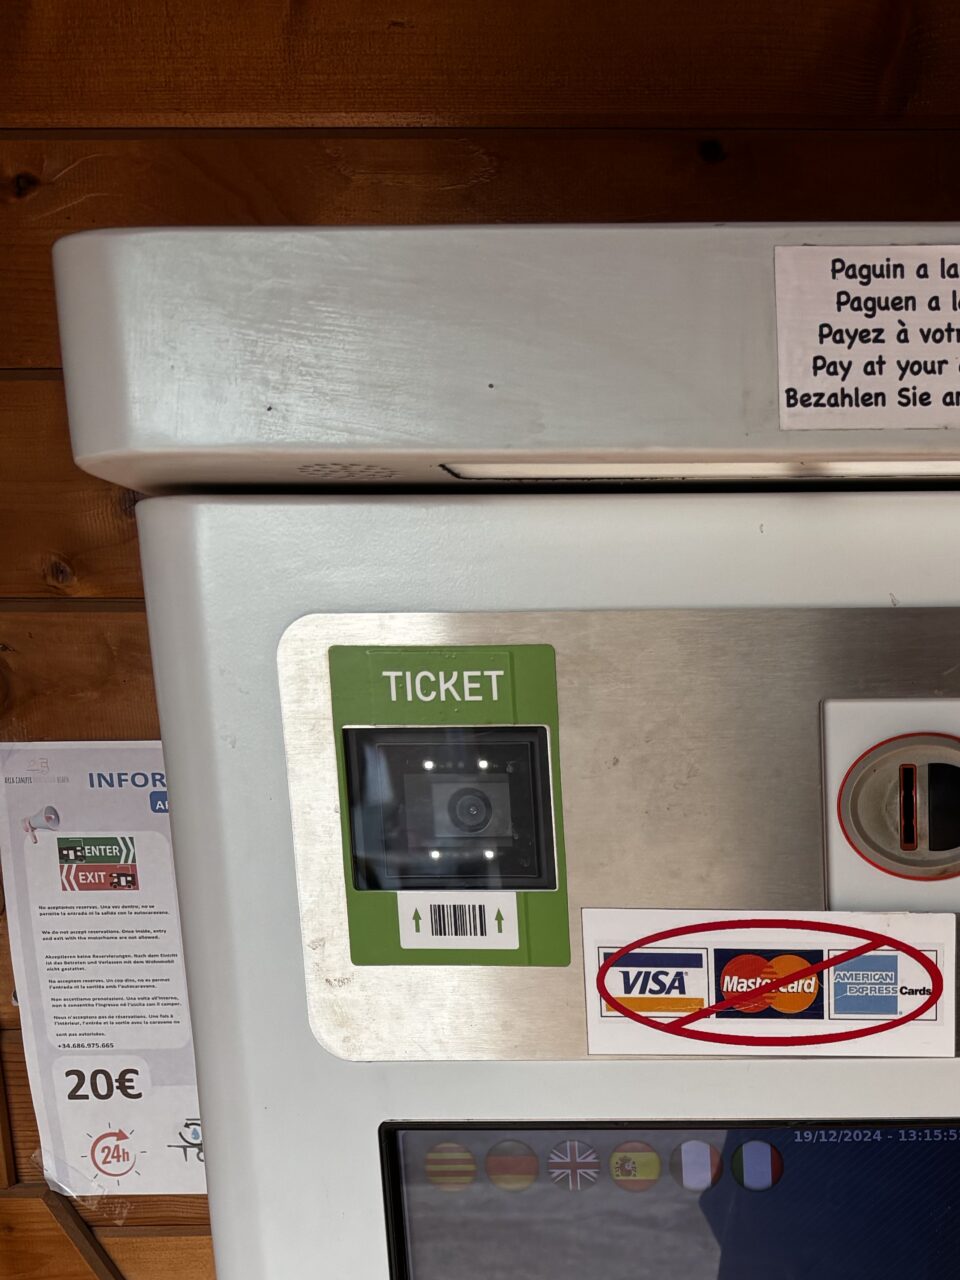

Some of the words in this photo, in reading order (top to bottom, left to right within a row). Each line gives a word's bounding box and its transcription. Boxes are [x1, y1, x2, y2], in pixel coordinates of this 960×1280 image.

[830, 257, 905, 287] Paguin
[915, 262, 930, 280] a
[940, 257, 960, 280] la
[835, 290, 917, 319] Paguen
[927, 295, 941, 312] a
[818, 322, 886, 350] Payez
[896, 318, 910, 344] à
[812, 354, 853, 382] Pay
[862, 354, 887, 377] at
[896, 359, 949, 382] your
[784, 386, 887, 409] Bezahlen
[897, 385, 932, 408] Sie
[382, 671, 504, 701] TICKET
[89, 772, 167, 788] INFOR
[84, 845, 120, 857] ENTER
[79, 872, 106, 883] EXIT
[618, 970, 688, 995] VISA
[723, 975, 816, 994] MasteCard
[834, 971, 895, 984] AMERICAN
[847, 984, 898, 996] EXPRESS
[900, 986, 933, 996] Cards
[64, 1068, 142, 1100] 20€
[794, 1130, 882, 1142] 19/12/2024
[101, 1144, 130, 1165] 24h
